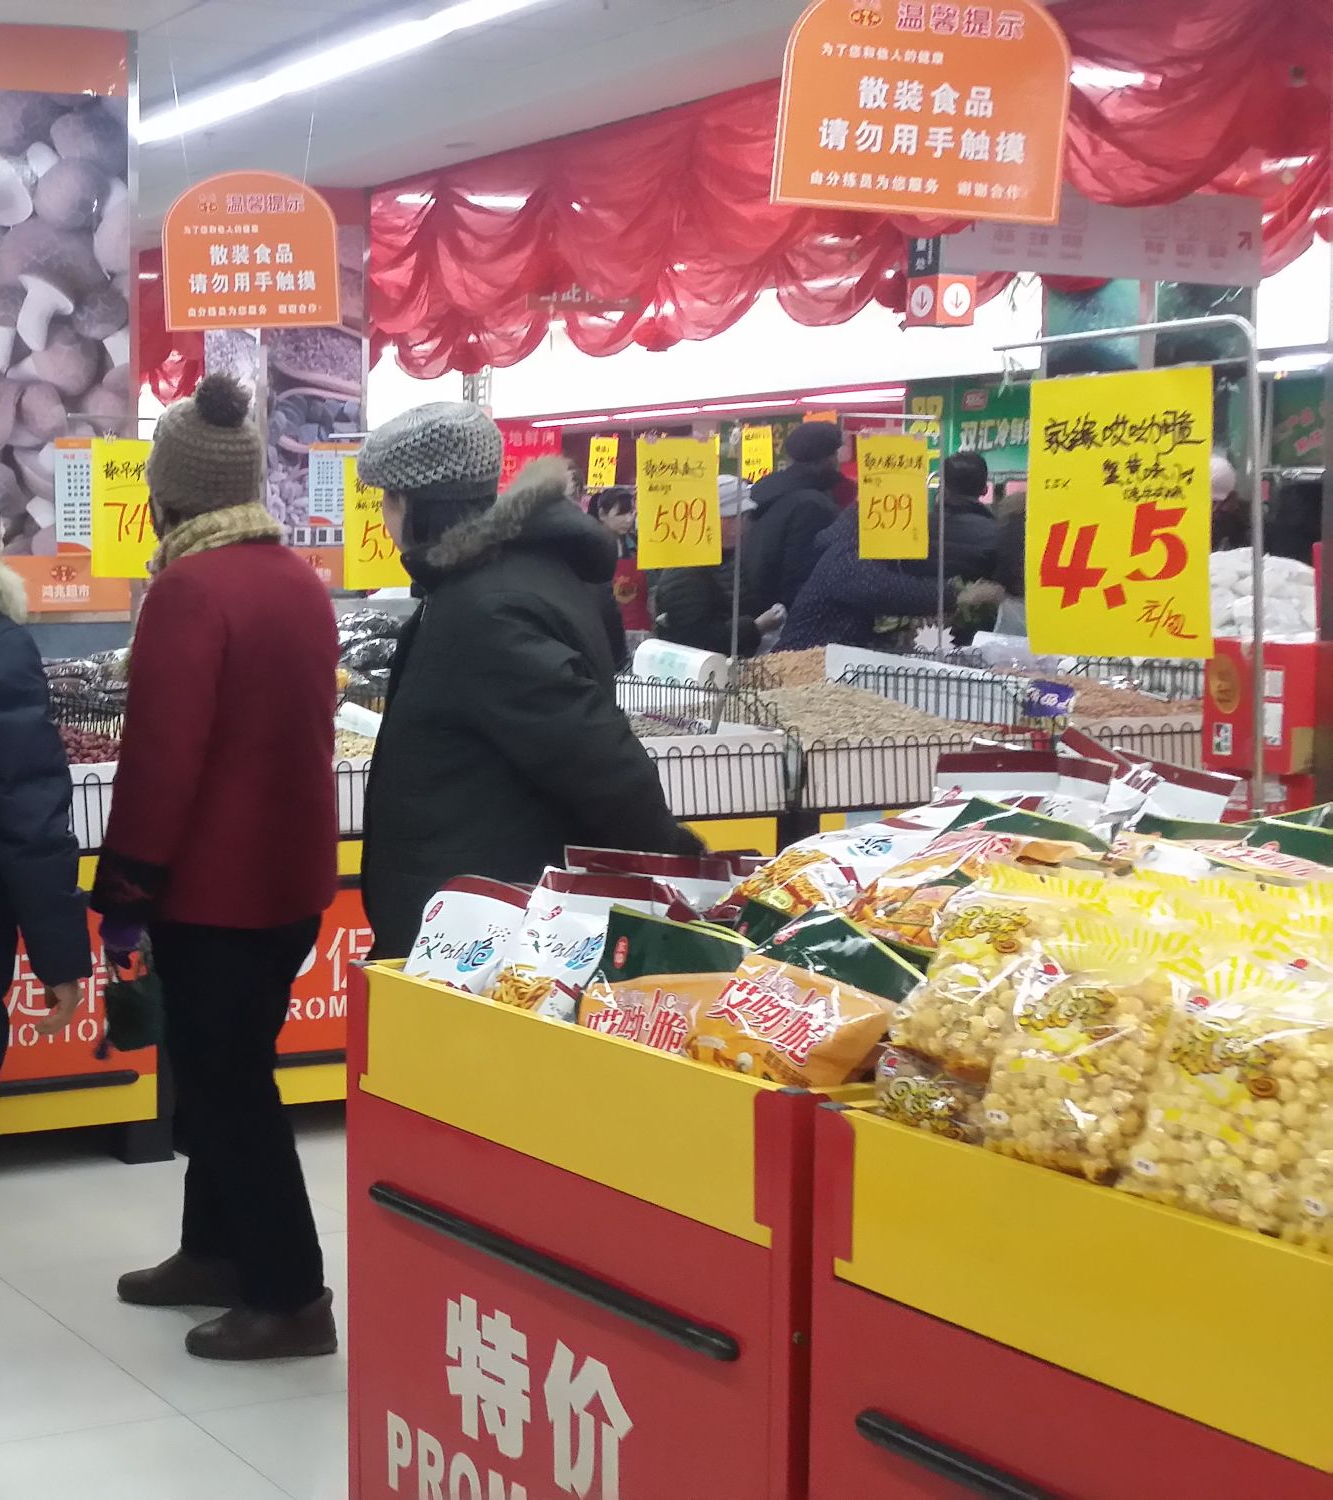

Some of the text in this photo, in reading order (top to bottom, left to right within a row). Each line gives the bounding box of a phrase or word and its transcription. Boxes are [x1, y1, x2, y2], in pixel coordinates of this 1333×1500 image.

[896, 2, 1025, 40] 温馨提示
[858, 76, 994, 118] 散装食品
[819, 117, 1027, 164] 请勿用手触摸
[226, 193, 305, 214] 温馨提示
[209, 244, 293, 265] 散装食品
[188, 270, 316, 293] 请勿用手触摸
[649, 498, 706, 545] 5.99
[864, 493, 912, 531] 5.99
[1040, 501, 1188, 610] 4.5
[446, 1293, 633, 1500] 特价
